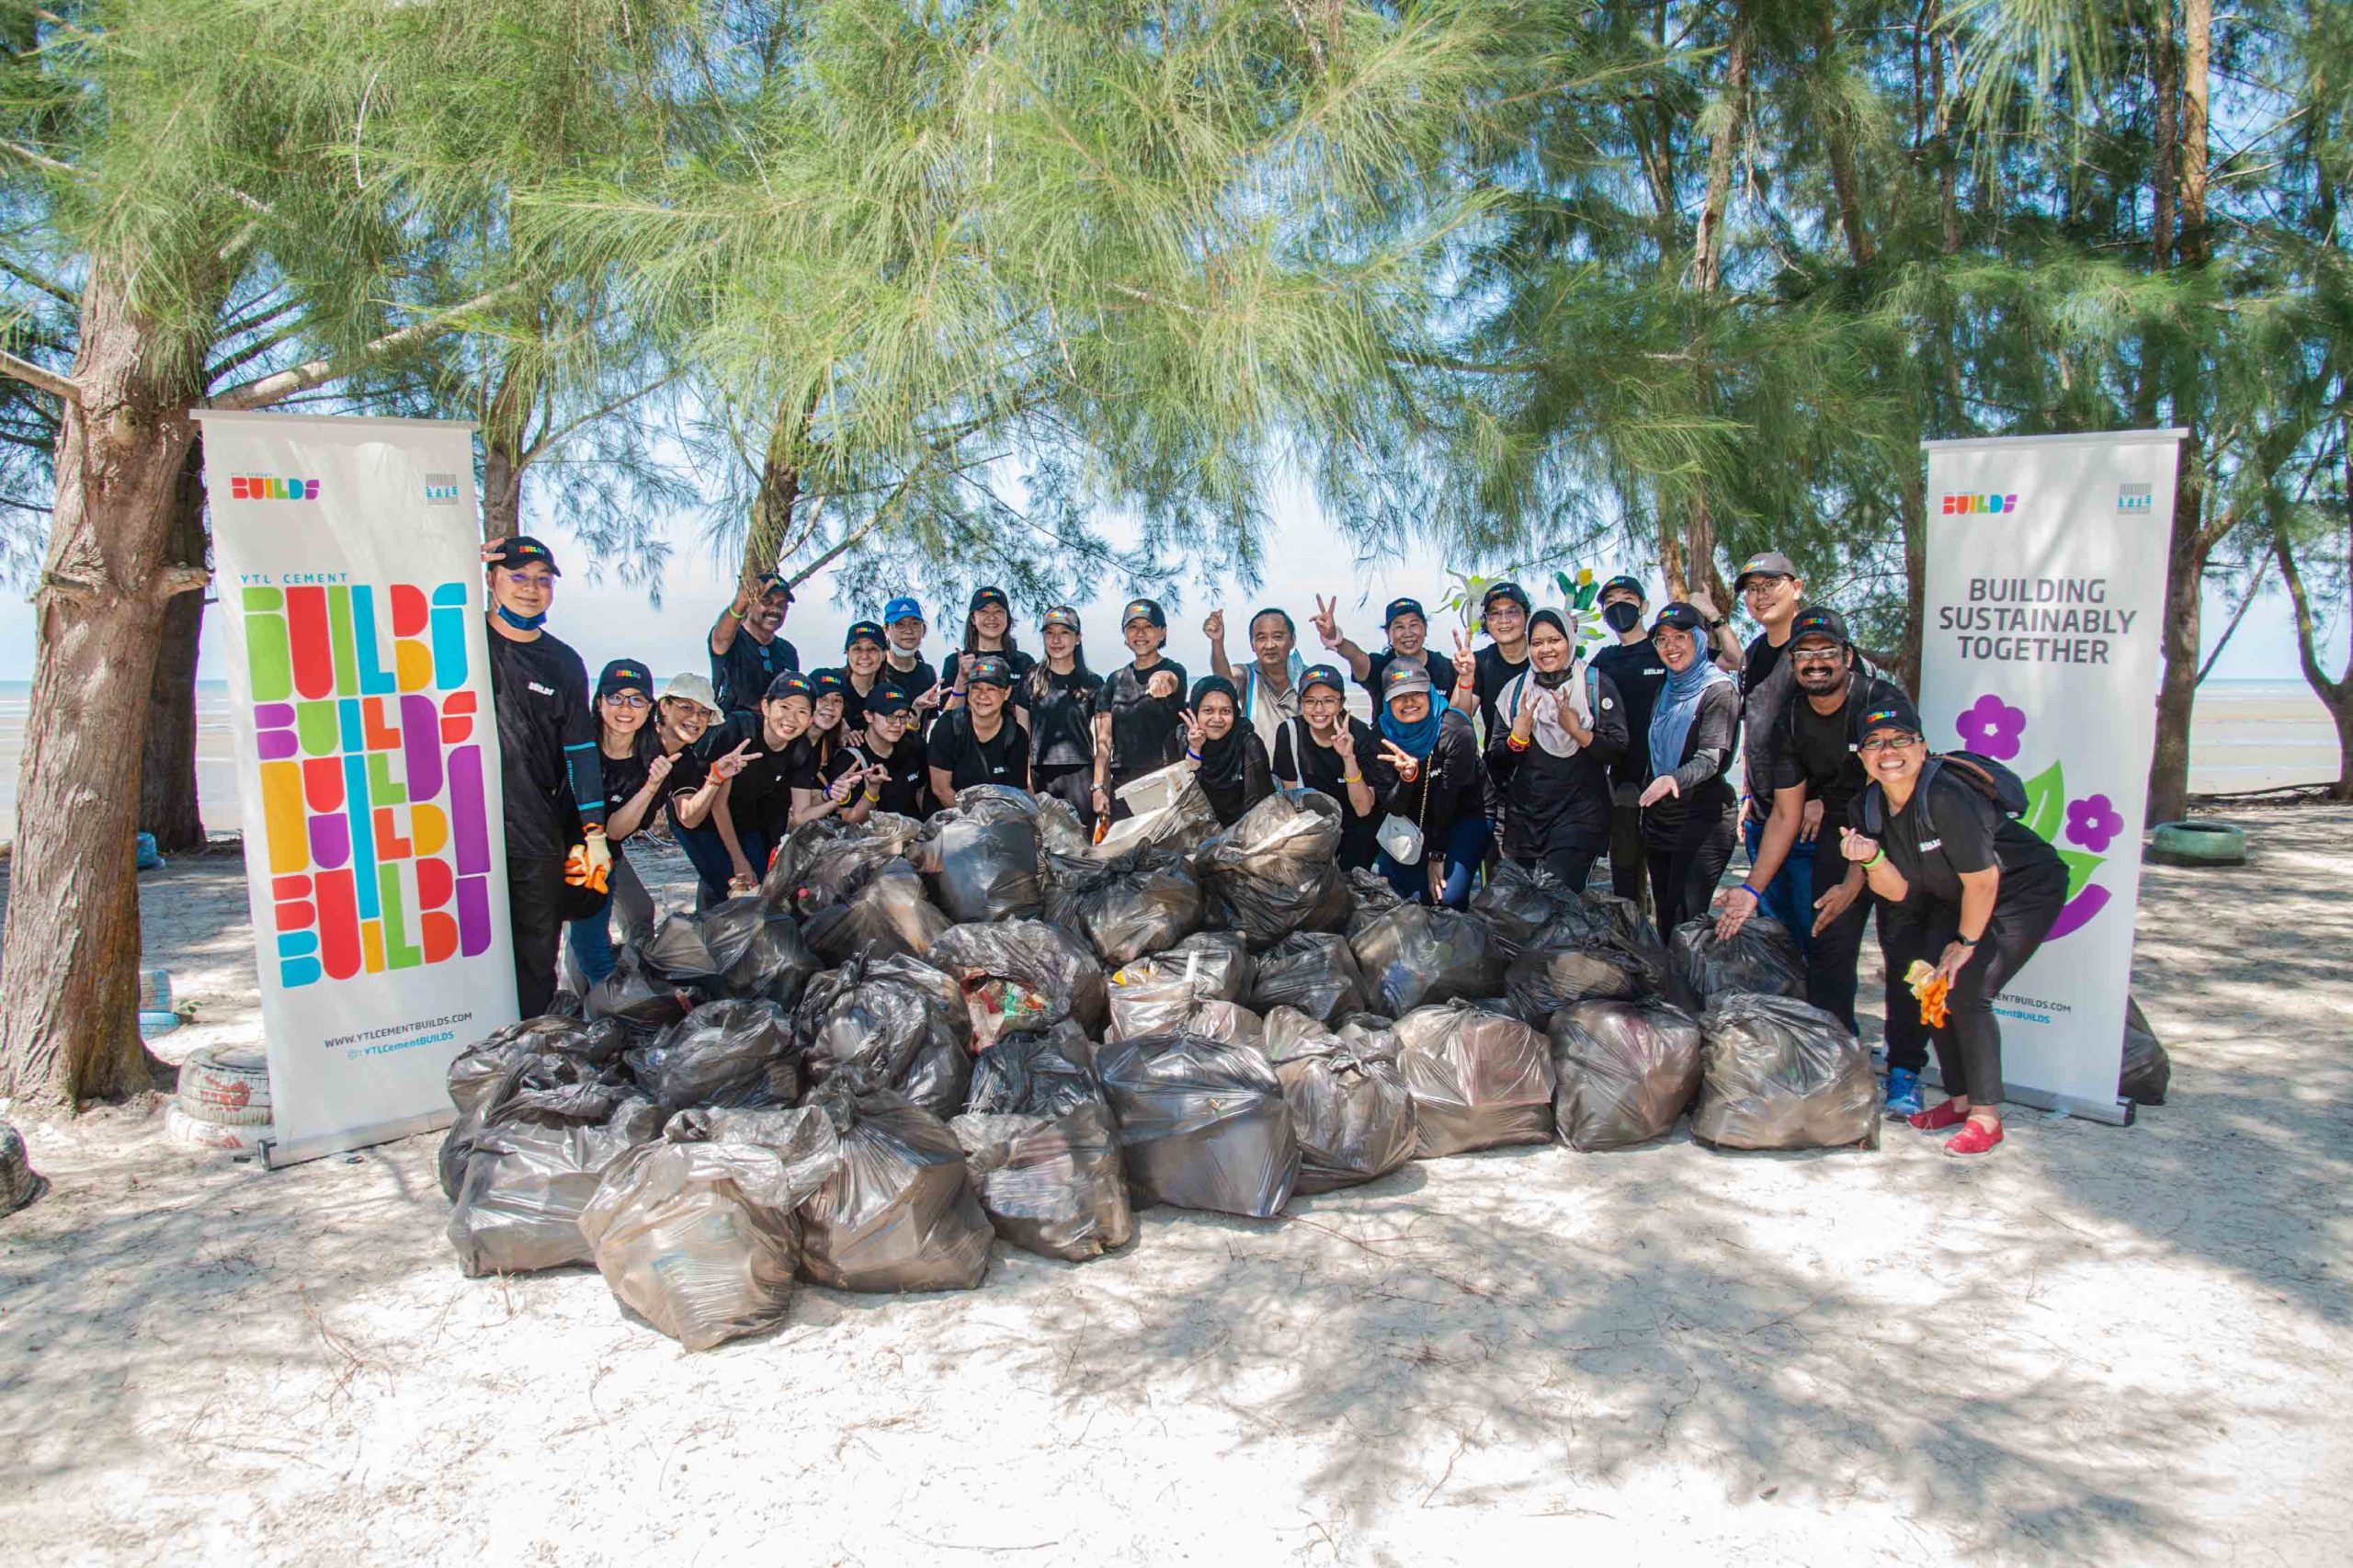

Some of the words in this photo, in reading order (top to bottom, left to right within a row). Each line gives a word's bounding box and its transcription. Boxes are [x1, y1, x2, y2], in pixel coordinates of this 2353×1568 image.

[231, 478, 320, 500] BUILDS
[1942, 494, 2018, 515] BUILDS
[240, 574, 271, 585] YTL
[282, 573, 347, 584] CEMENT
[1969, 578, 2107, 604] BUILDING
[1939, 606, 2138, 634] SUSTAINABLY
[1957, 636, 2109, 664] TOGETHER
[1995, 994, 2072, 1013] ENTBUILDS.COM
[1993, 1007, 2052, 1025] mentBUILDS
[324, 1012, 473, 1048] WWW.YTLCEMENTBUILDS.COM
[363, 1030, 455, 1055] YTLCementBUILDS
